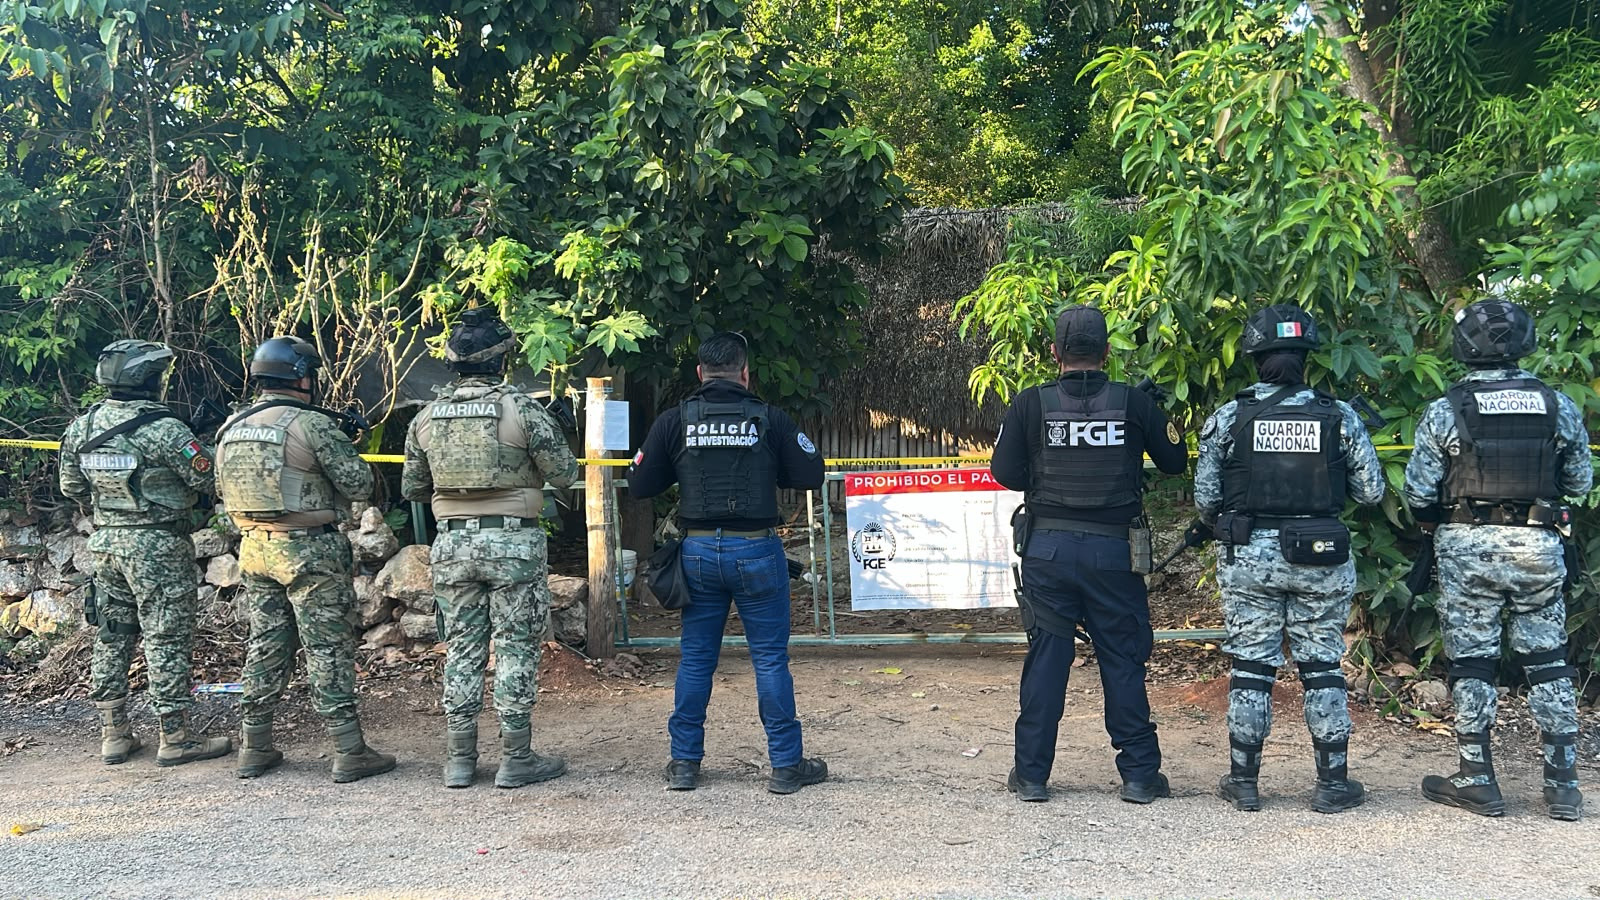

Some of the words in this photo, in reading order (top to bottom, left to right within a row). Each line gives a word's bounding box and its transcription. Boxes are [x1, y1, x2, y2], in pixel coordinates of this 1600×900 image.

[1481, 391, 1538, 400] GUARDIA
[432, 403, 496, 417] MARINA
[1479, 400, 1544, 411] NACIONAL
[224, 428, 277, 442] MARINA
[687, 421, 758, 435] POLICÍA
[1069, 421, 1125, 446] FGE
[1258, 422, 1316, 436] GUARDIA
[686, 437, 697, 446] DE
[1256, 436, 1317, 450] NACIONAL
[854, 474, 942, 488] PROHIBIDO
[948, 474, 965, 484] EL
[971, 473, 996, 483] PA
[863, 558, 886, 570] FGE
